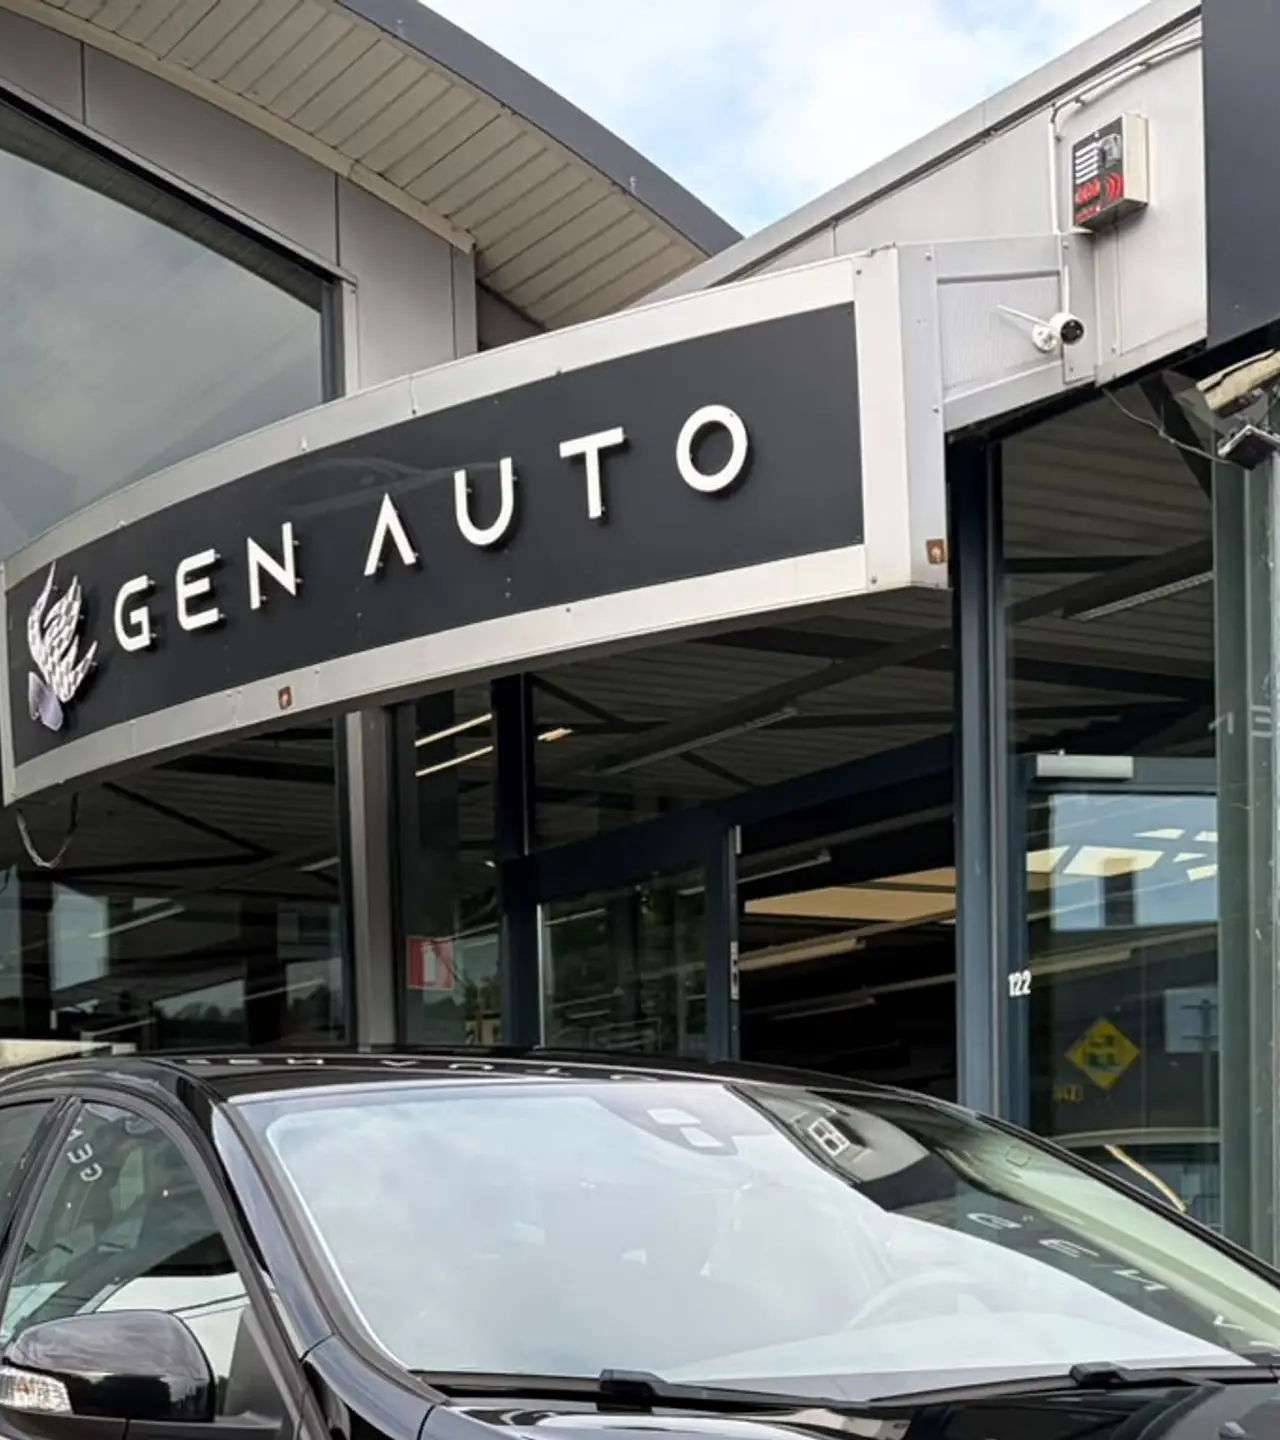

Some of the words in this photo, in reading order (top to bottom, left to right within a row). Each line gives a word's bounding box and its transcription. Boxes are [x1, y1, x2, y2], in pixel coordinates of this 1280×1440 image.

[114, 522, 298, 651] GEN
[364, 404, 748, 576] AUTO
[1009, 970, 1031, 997] 122
